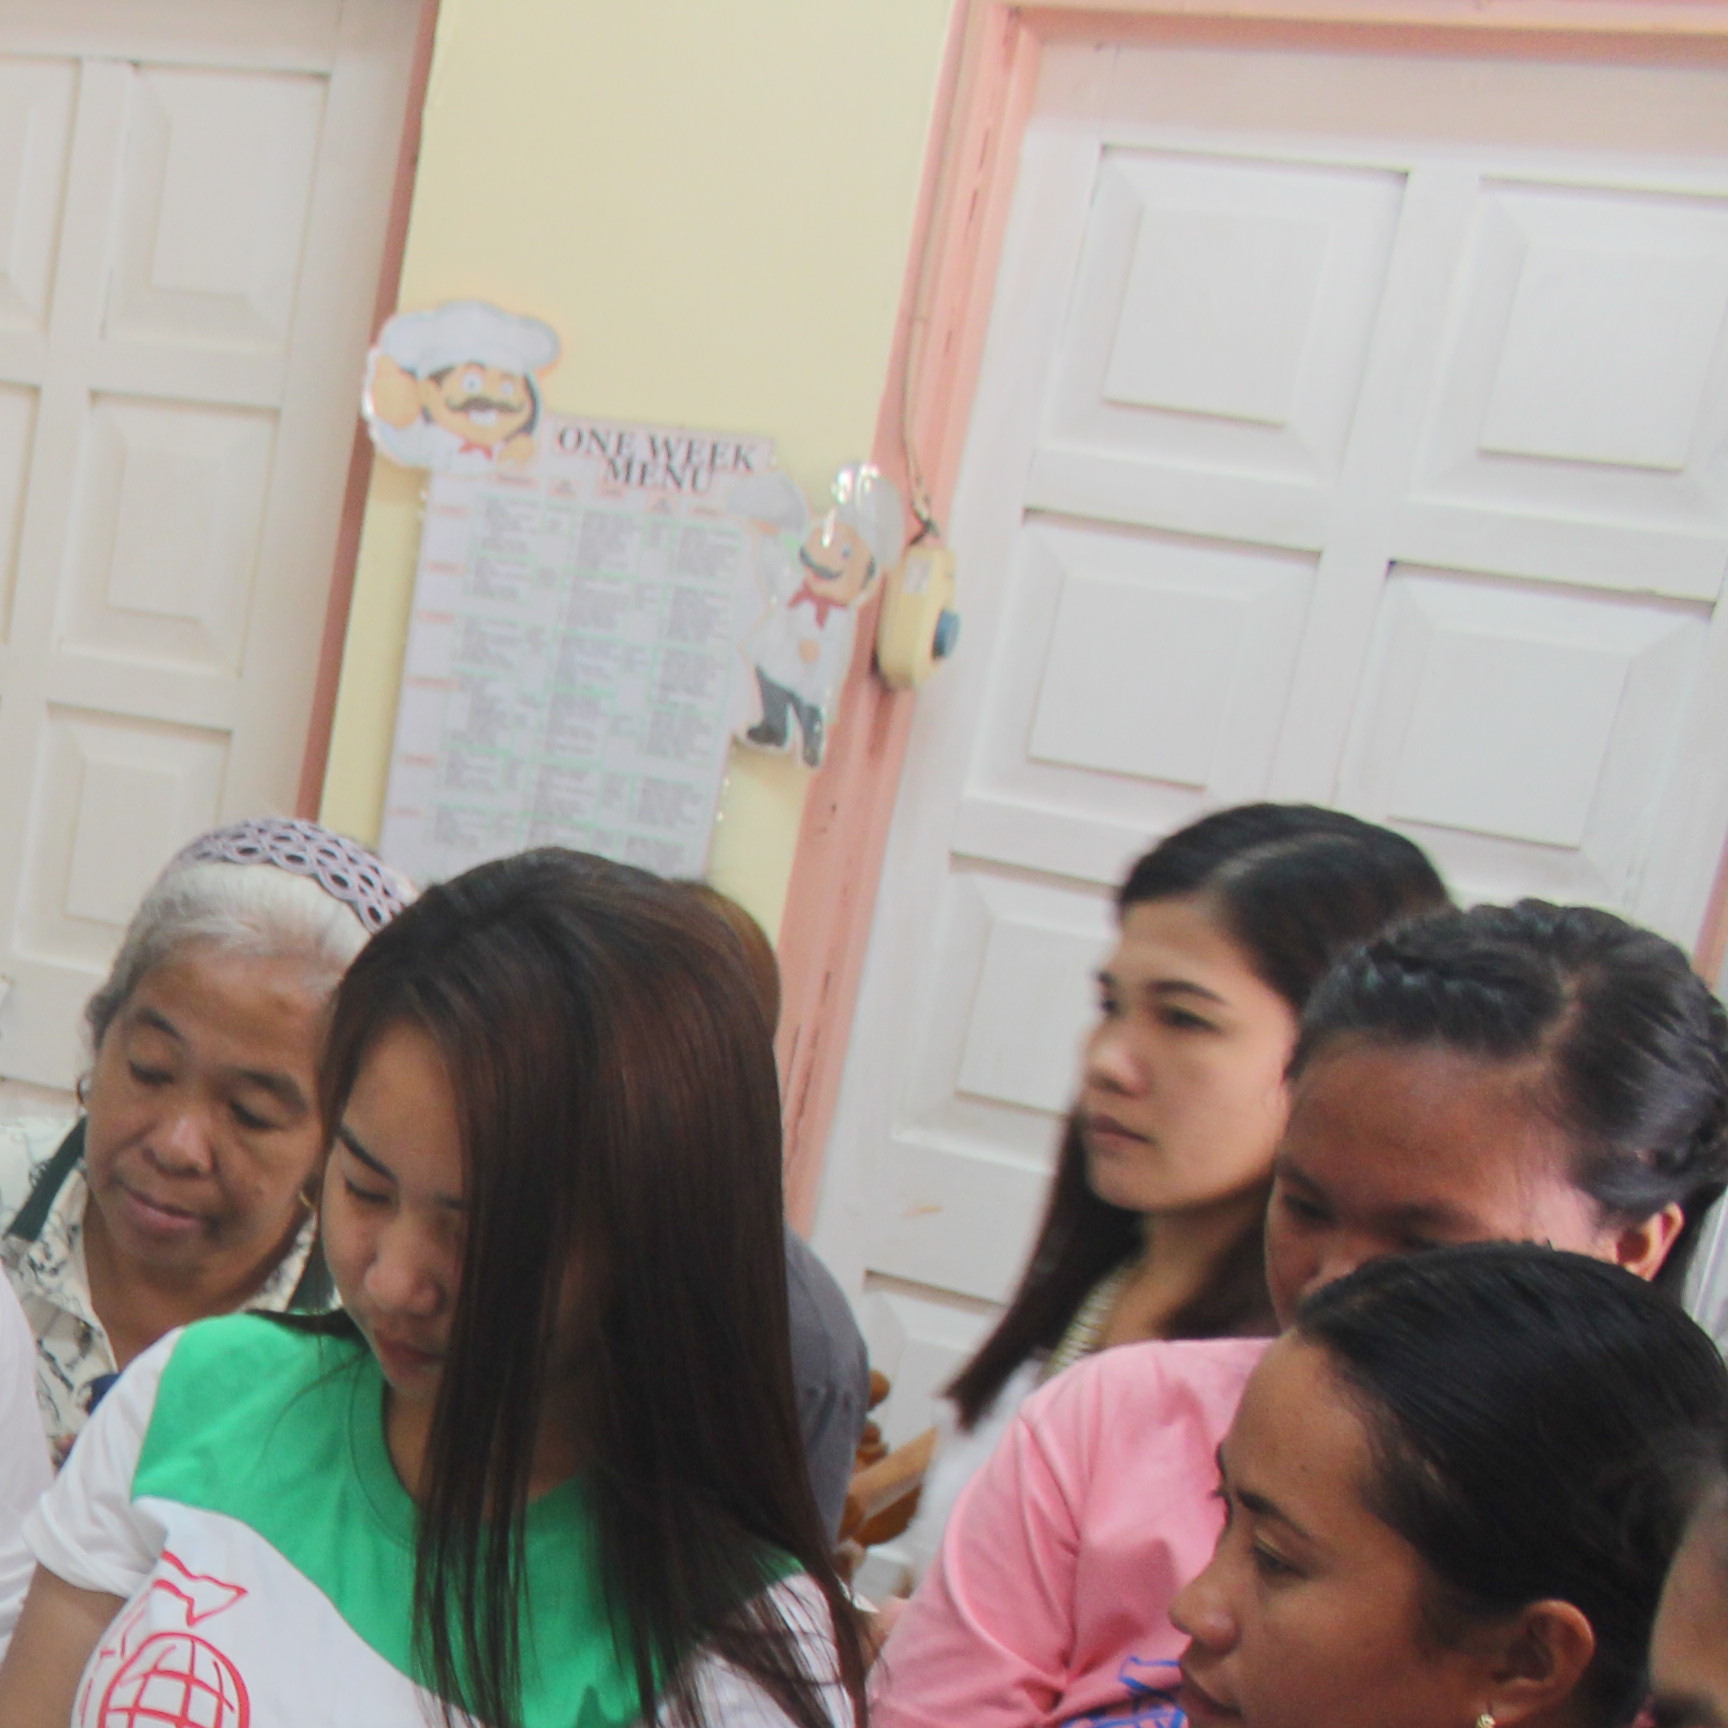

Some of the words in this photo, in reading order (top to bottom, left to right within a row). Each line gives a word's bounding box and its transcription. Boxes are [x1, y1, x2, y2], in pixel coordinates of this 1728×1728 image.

[558, 428, 634, 459] ONE
[649, 434, 755, 473] WEEK
[605, 457, 714, 493] MENU
